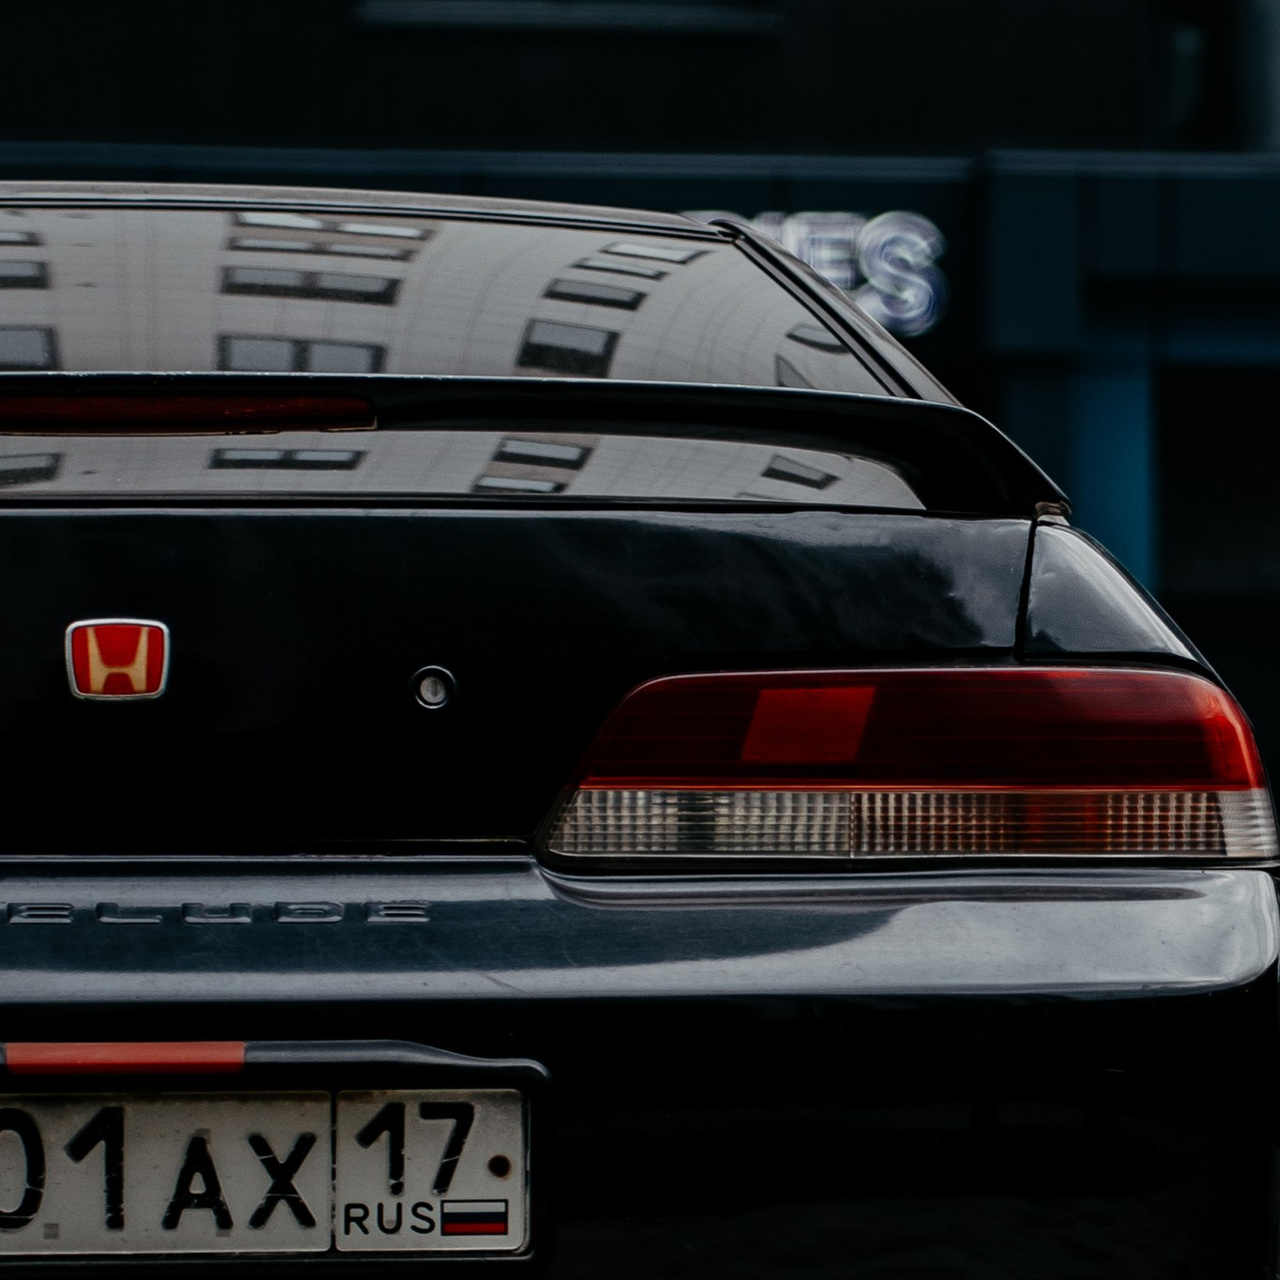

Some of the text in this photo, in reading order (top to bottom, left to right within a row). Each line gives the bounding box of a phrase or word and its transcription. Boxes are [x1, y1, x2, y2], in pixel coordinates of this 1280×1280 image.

[678, 210, 947, 336] ES
[355, 1101, 476, 1195] 17
[343, 1201, 437, 1236] RUS
